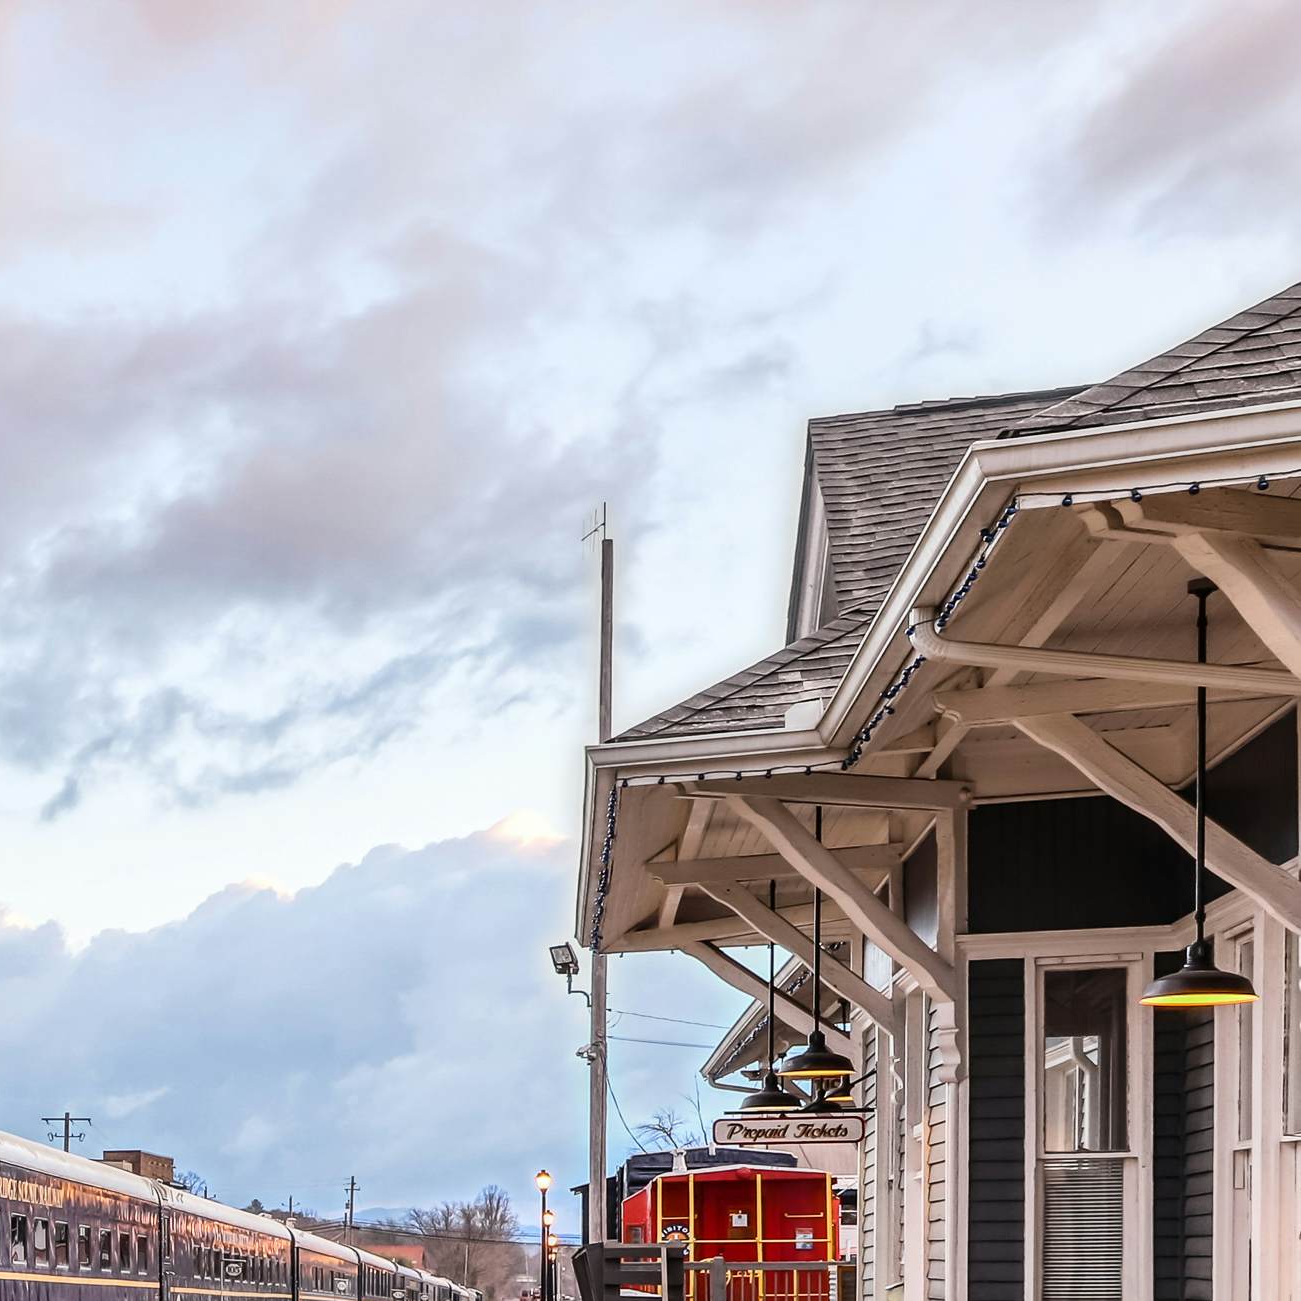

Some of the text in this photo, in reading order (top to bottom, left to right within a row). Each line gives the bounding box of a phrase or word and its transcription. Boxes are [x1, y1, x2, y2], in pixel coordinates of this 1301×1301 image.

[727, 1122, 848, 1141] Prepaid Tickets
[662, 1225, 691, 1237] VISITO
